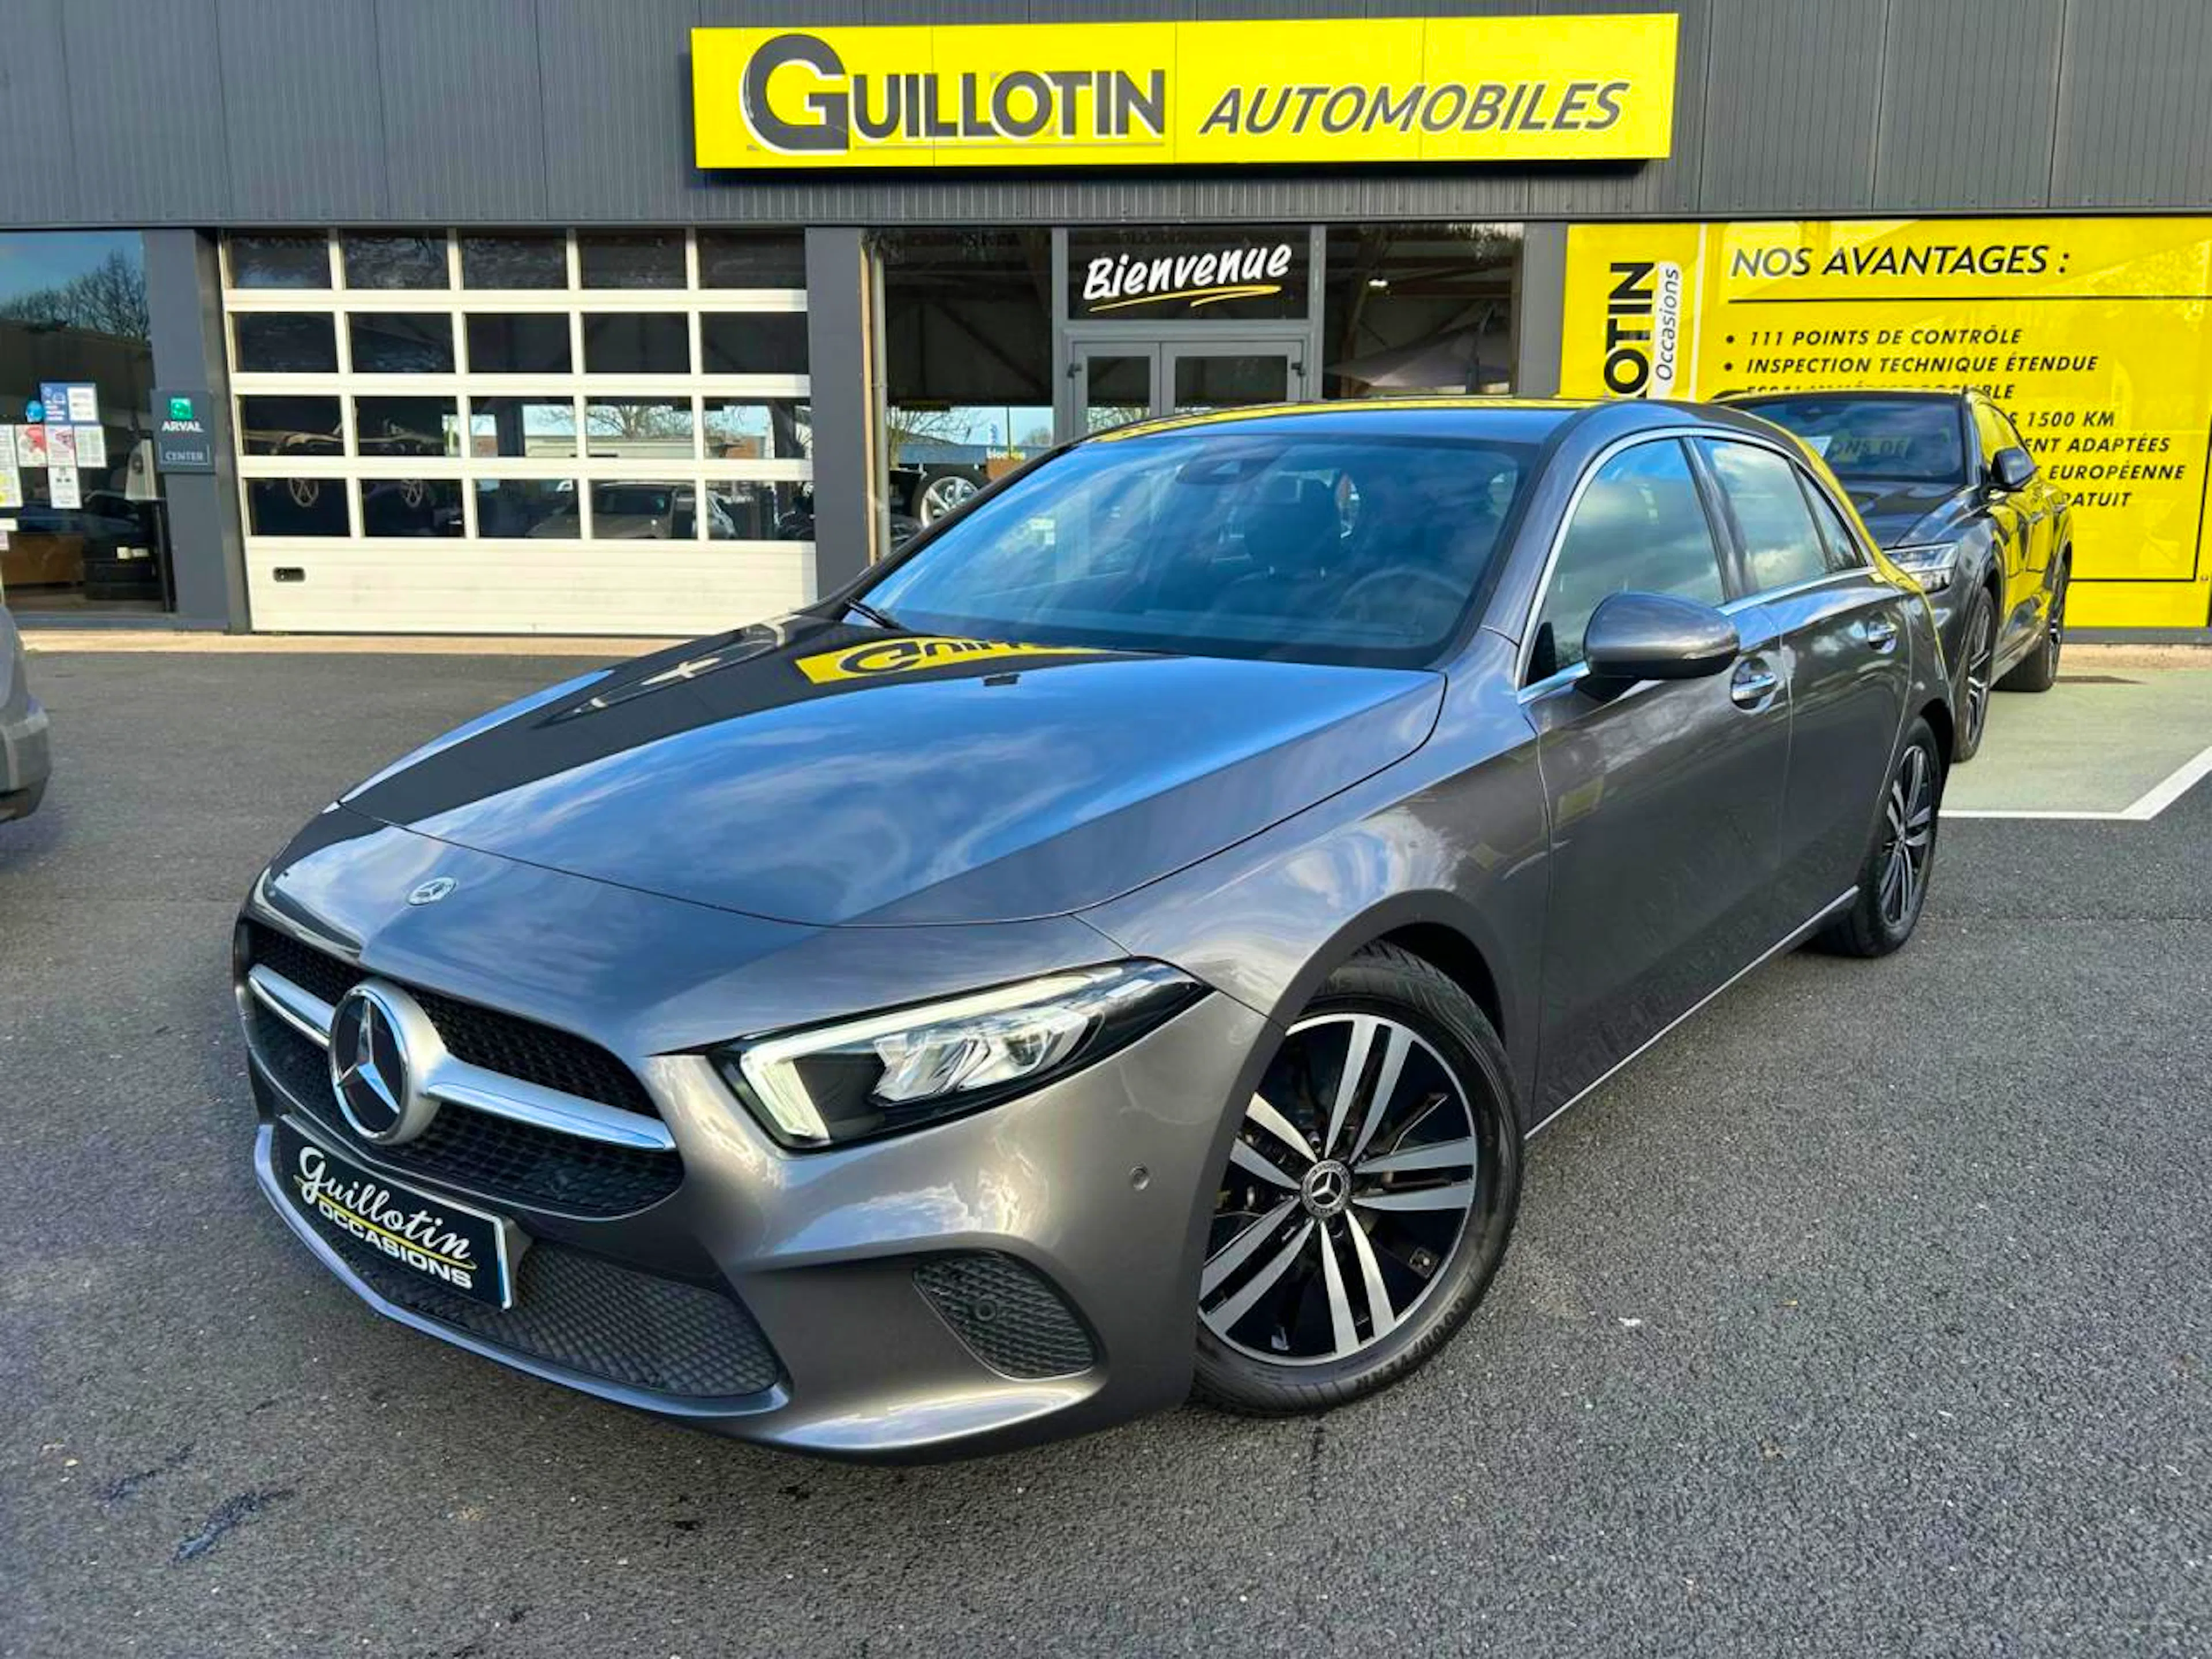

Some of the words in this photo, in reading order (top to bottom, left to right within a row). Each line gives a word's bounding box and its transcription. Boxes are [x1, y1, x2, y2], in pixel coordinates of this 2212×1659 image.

[744, 33, 1165, 151] GUILLOTIN
[1199, 82, 1630, 134] AUTOMOBILES
[1084, 244, 1292, 300] Bienvenue
[1731, 247, 1813, 276] NOS
[1821, 245, 2050, 275] AVANTAGES
[1604, 262, 1654, 399] OTIN
[1656, 268, 1679, 380] Occasions
[1751, 331, 1783, 346] 111
[1792, 329, 1870, 346] POINTS
[1876, 329, 1904, 344] DE
[1911, 325, 2022, 345] CONTRÔLE
[1747, 357, 1872, 373] INSPECTION
[1879, 357, 1999, 373] TECHNIQUE
[2005, 351, 2099, 372] ÉTENDUE
[161, 421, 204, 432] ARVAL
[2028, 411, 2075, 427] 1500
[2082, 411, 2115, 427] KM
[2067, 433, 2171, 453] ADAPTÉES
[2049, 461, 2187, 480] EUROPÉENNE
[298, 1146, 471, 1259] Guillotin
[318, 1201, 474, 1290] OCCASIONS
